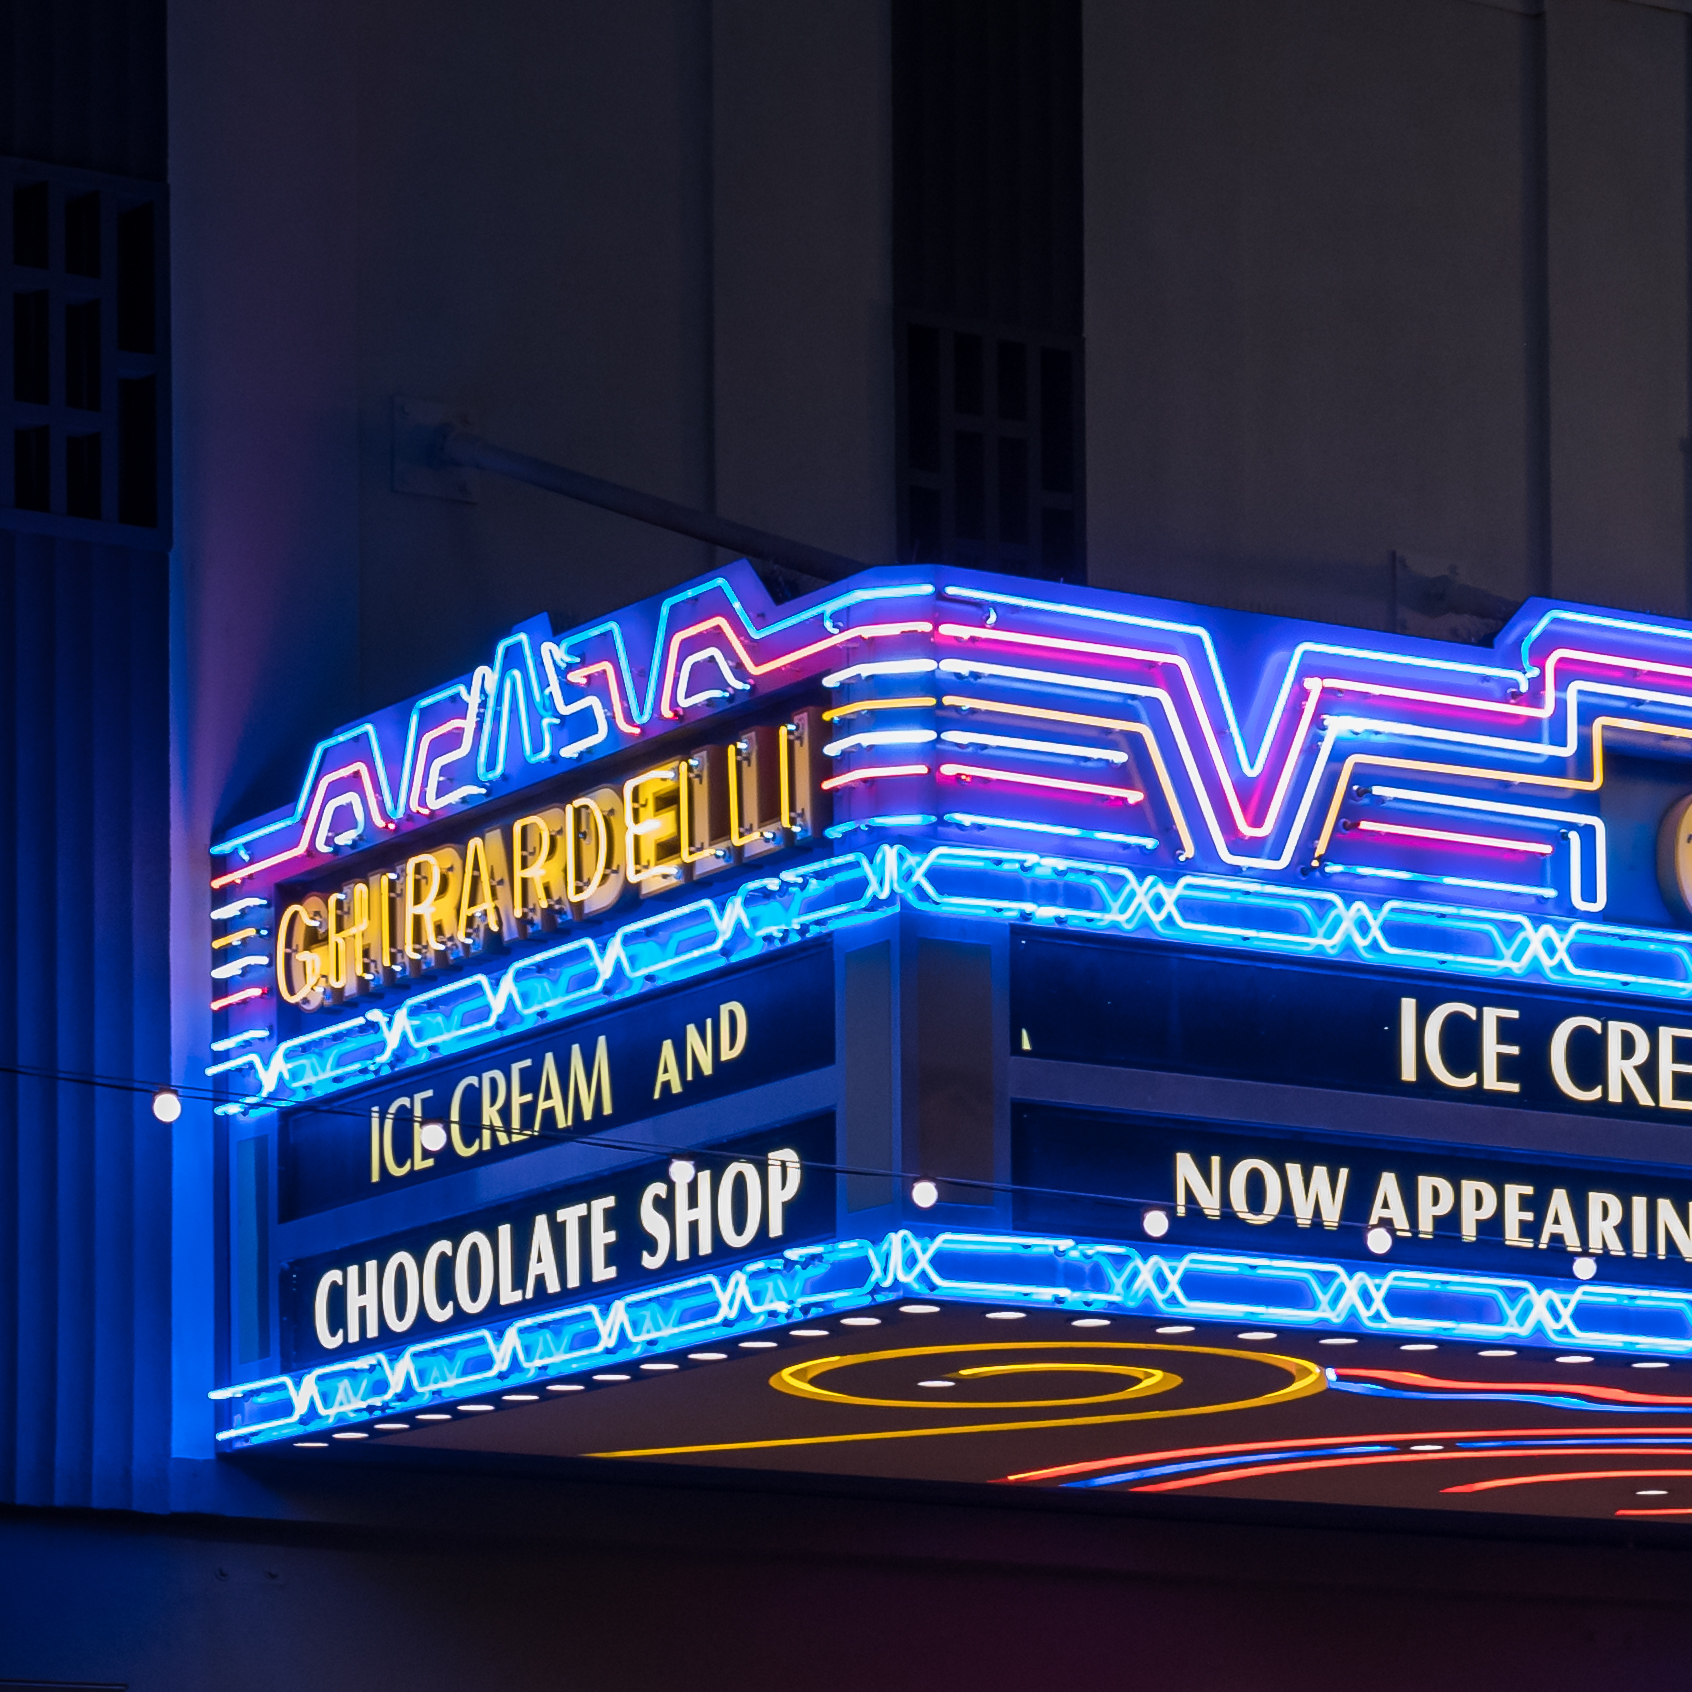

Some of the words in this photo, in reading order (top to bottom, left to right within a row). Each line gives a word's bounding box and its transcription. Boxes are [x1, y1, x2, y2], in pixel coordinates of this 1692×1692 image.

[277, 706, 815, 1013] GHIRARDELLI
[370, 1088, 435, 1184] ICE
[448, 1034, 614, 1159] CREAM
[652, 1000, 750, 1101] AND
[1399, 997, 1521, 1093] ICE
[314, 1193, 618, 1350] CHOCOLATE
[639, 1145, 803, 1271] SHOP
[1174, 1151, 1349, 1230] NOW
